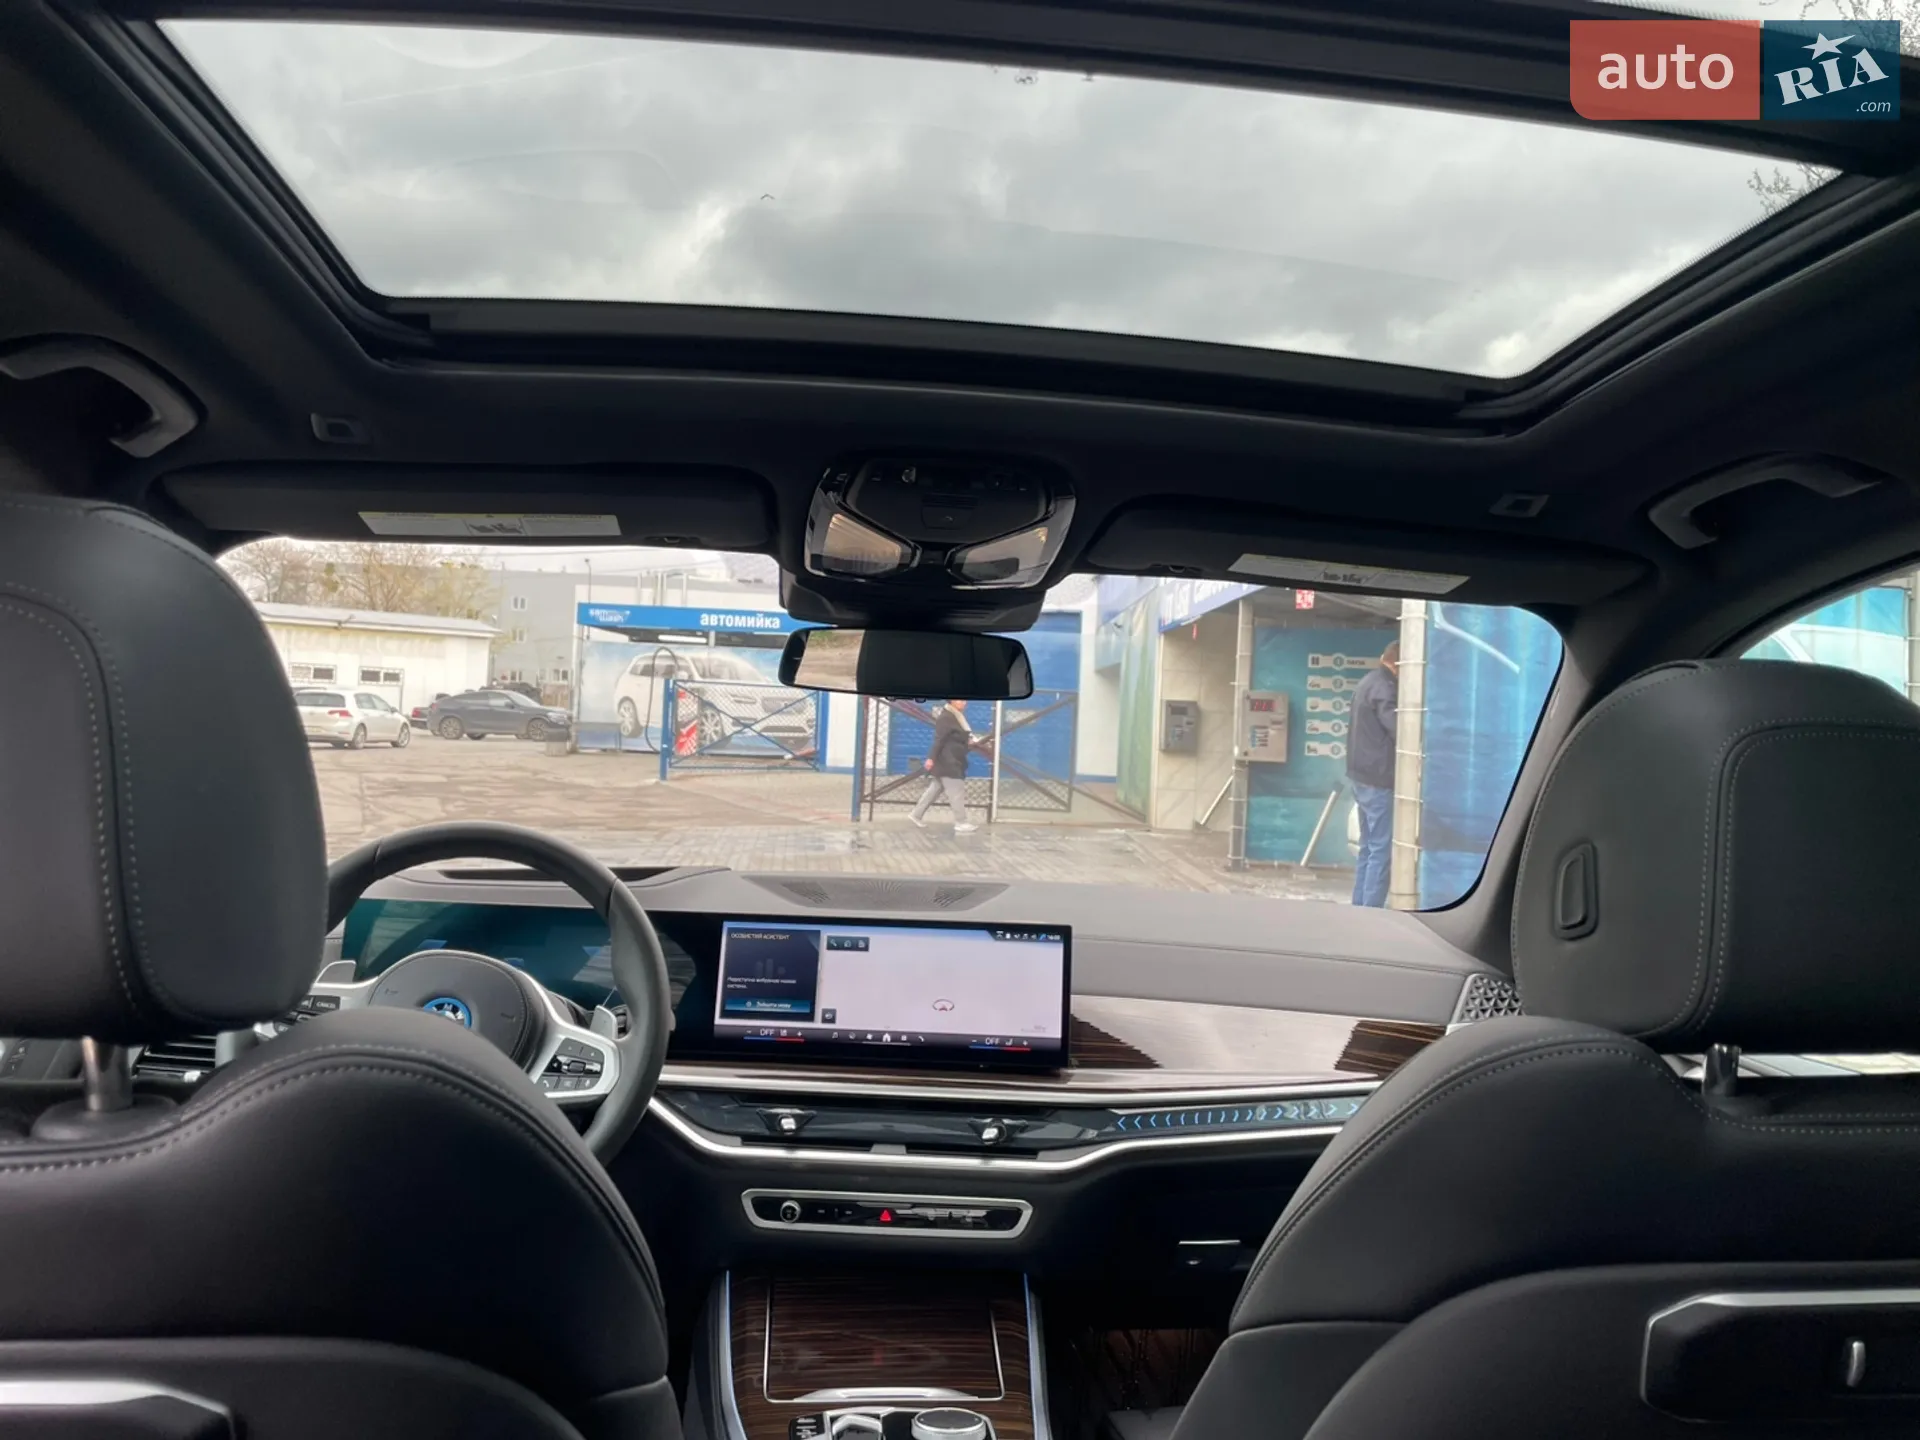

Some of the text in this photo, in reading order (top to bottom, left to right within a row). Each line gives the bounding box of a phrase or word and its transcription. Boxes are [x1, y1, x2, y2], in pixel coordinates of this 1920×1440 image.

[700, 613, 781, 629] автомийка
[760, 1028, 775, 1036] OFF
[985, 1037, 1000, 1045] OFF
